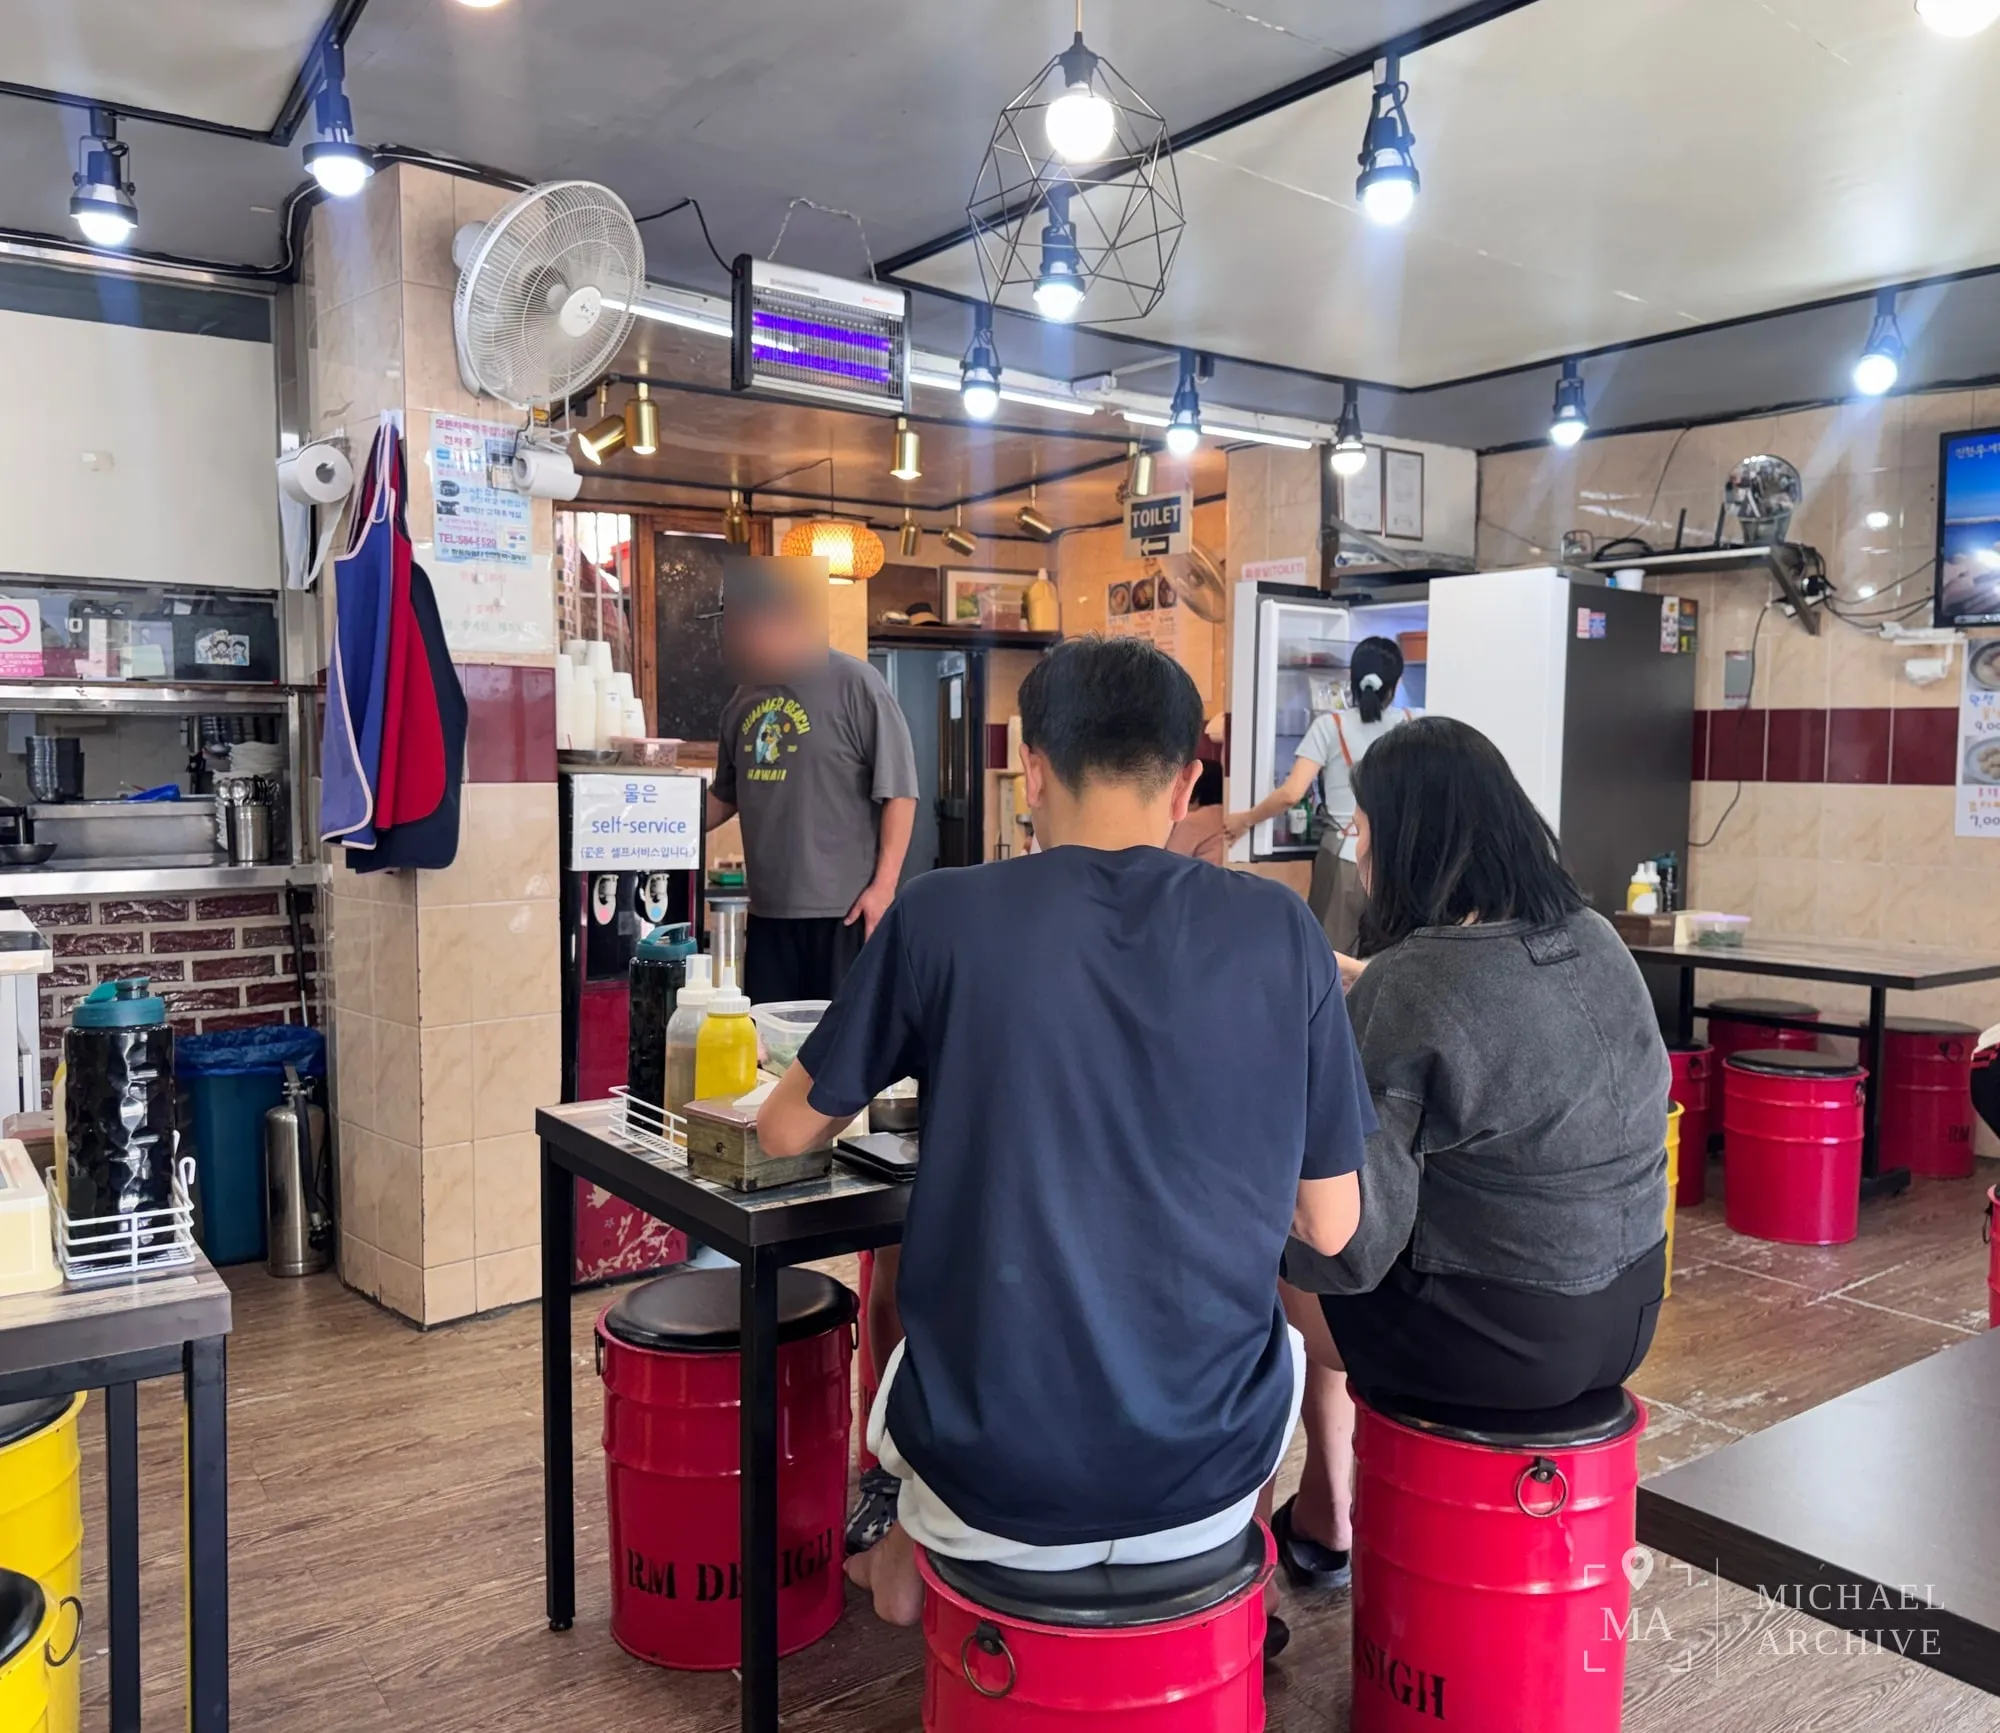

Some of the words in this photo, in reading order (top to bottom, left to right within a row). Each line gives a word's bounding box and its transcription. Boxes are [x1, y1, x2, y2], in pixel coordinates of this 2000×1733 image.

[1131, 504, 1181, 529] TOILET
[783, 699, 812, 735] BEACH
[592, 816, 687, 834] self-service
[626, 1548, 678, 1600] RM
